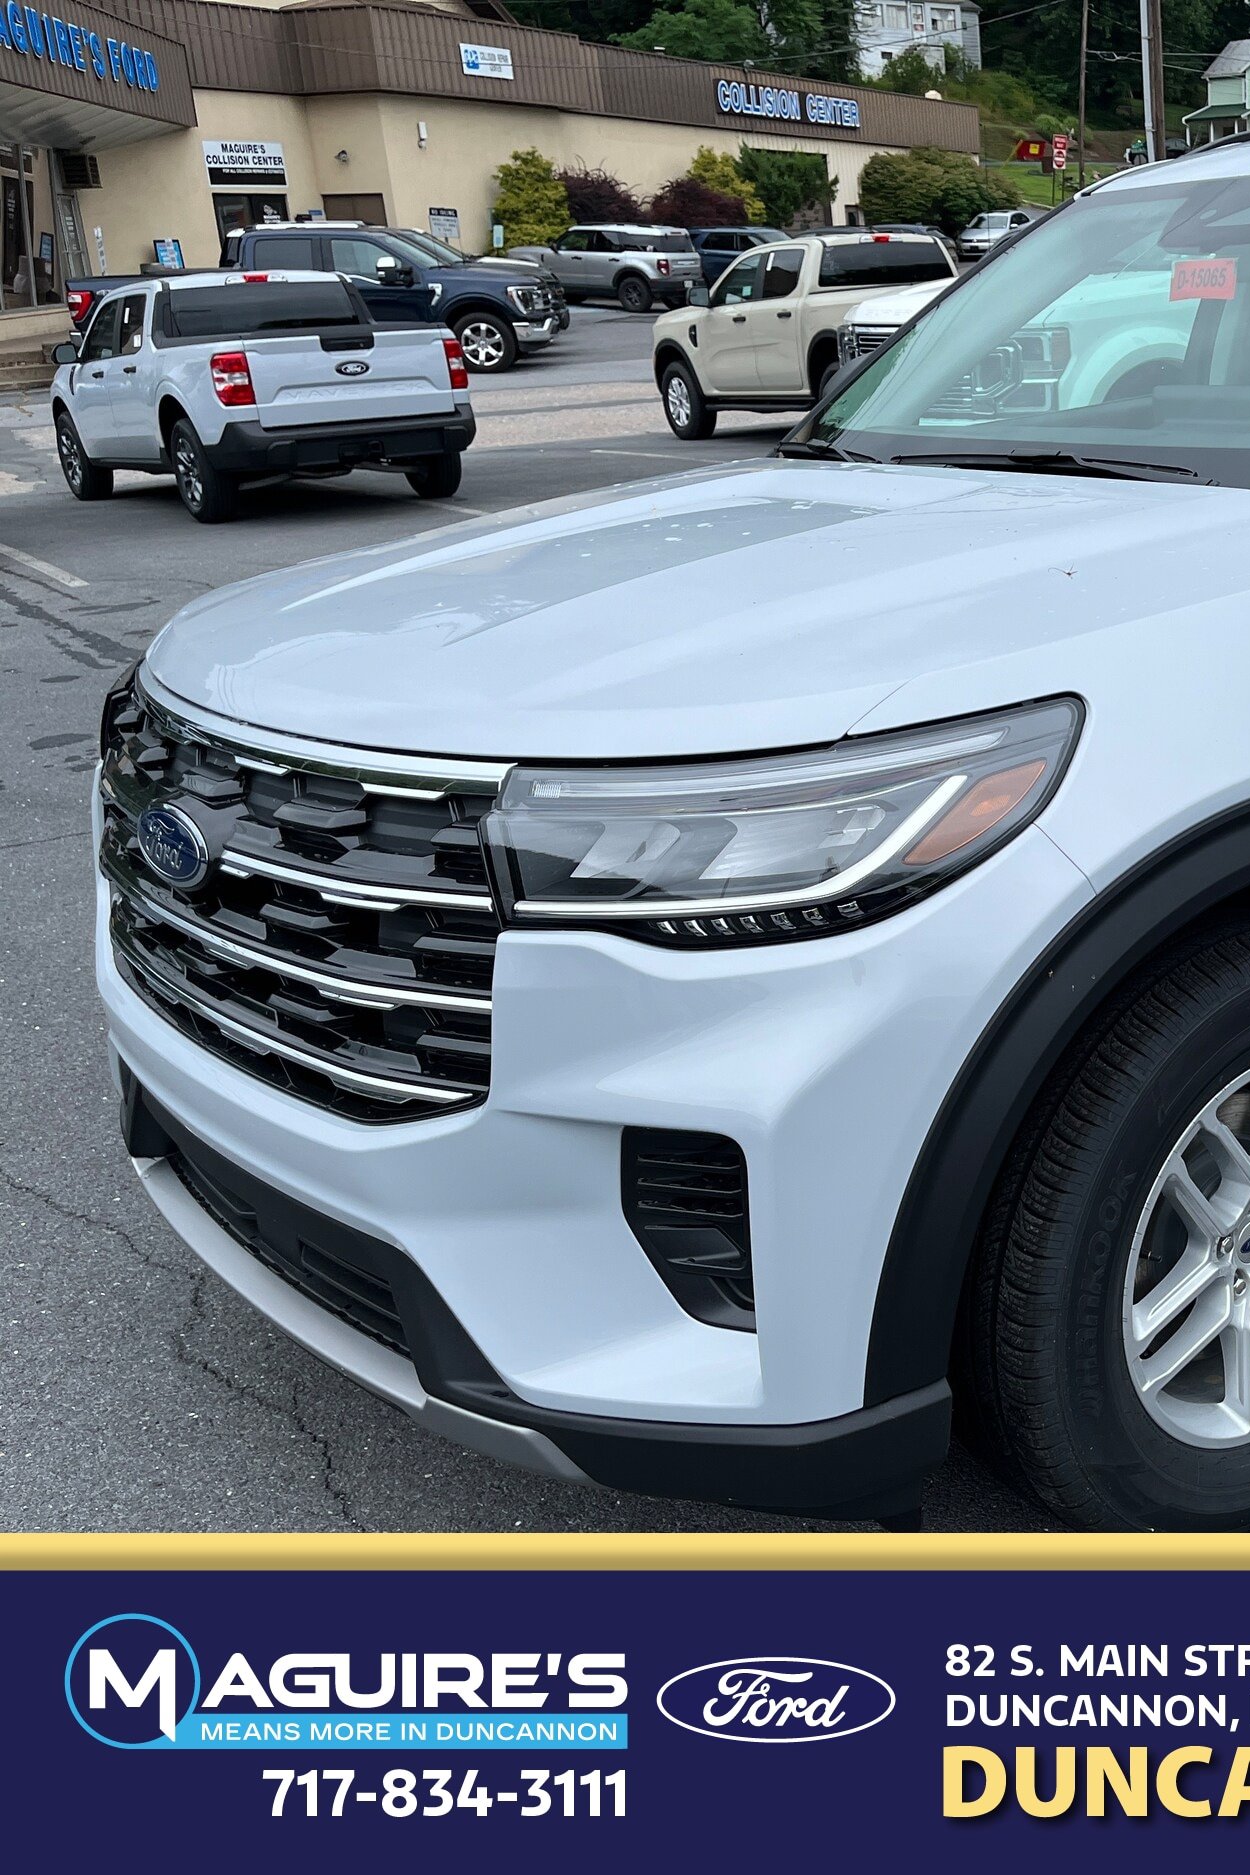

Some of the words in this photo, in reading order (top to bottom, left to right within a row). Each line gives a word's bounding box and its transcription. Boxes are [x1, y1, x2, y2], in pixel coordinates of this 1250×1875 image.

[0, 0, 106, 80] AGUIRE'S
[106, 37, 159, 92] FORD
[717, 79, 801, 120] COLLISION
[805, 93, 861, 128] CENTER
[205, 154, 250, 165] COLLISION
[252, 155, 284, 166] CENTER
[221, 143, 266, 154] MAGUIRE'S
[1178, 267, 1227, 290] D-15065
